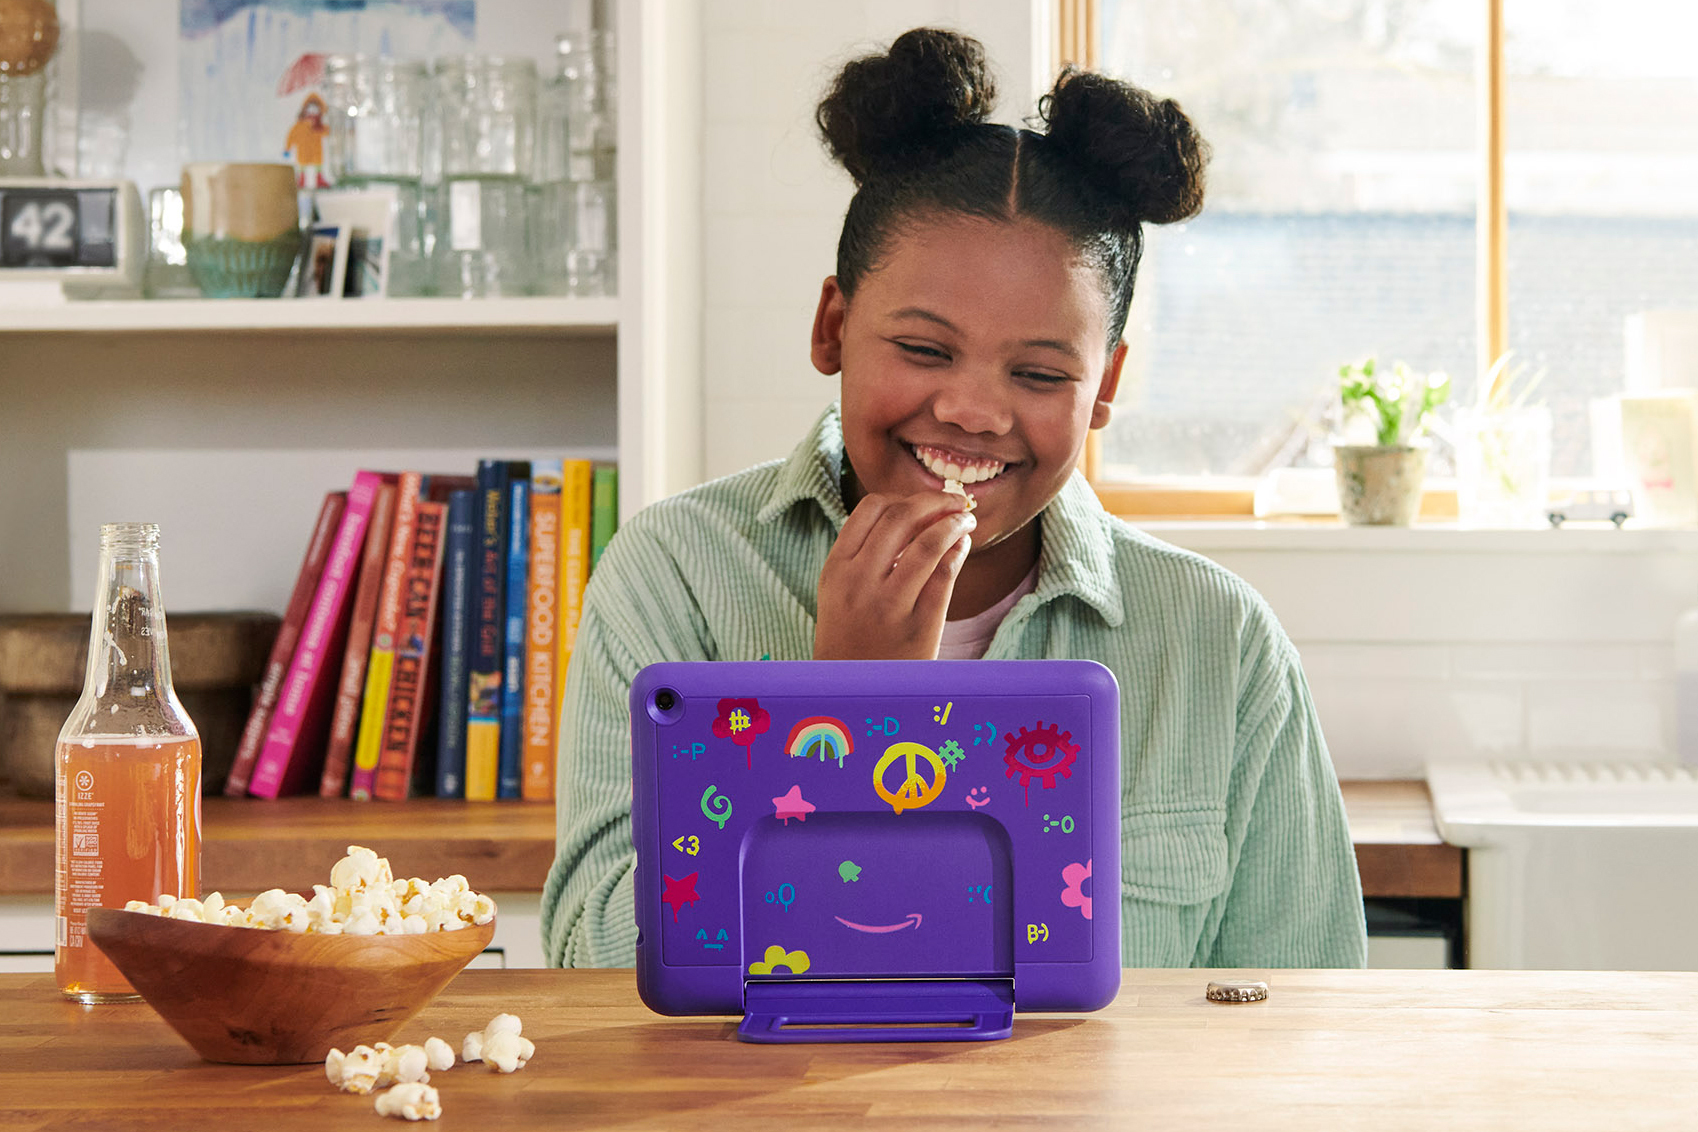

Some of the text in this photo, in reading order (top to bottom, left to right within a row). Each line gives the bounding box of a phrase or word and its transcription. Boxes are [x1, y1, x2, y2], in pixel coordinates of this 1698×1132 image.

[10, 202, 75, 250] 42
[529, 511, 555, 746] SUPERFOOD KITCHEN
[385, 655, 419, 753] CHICKEN
